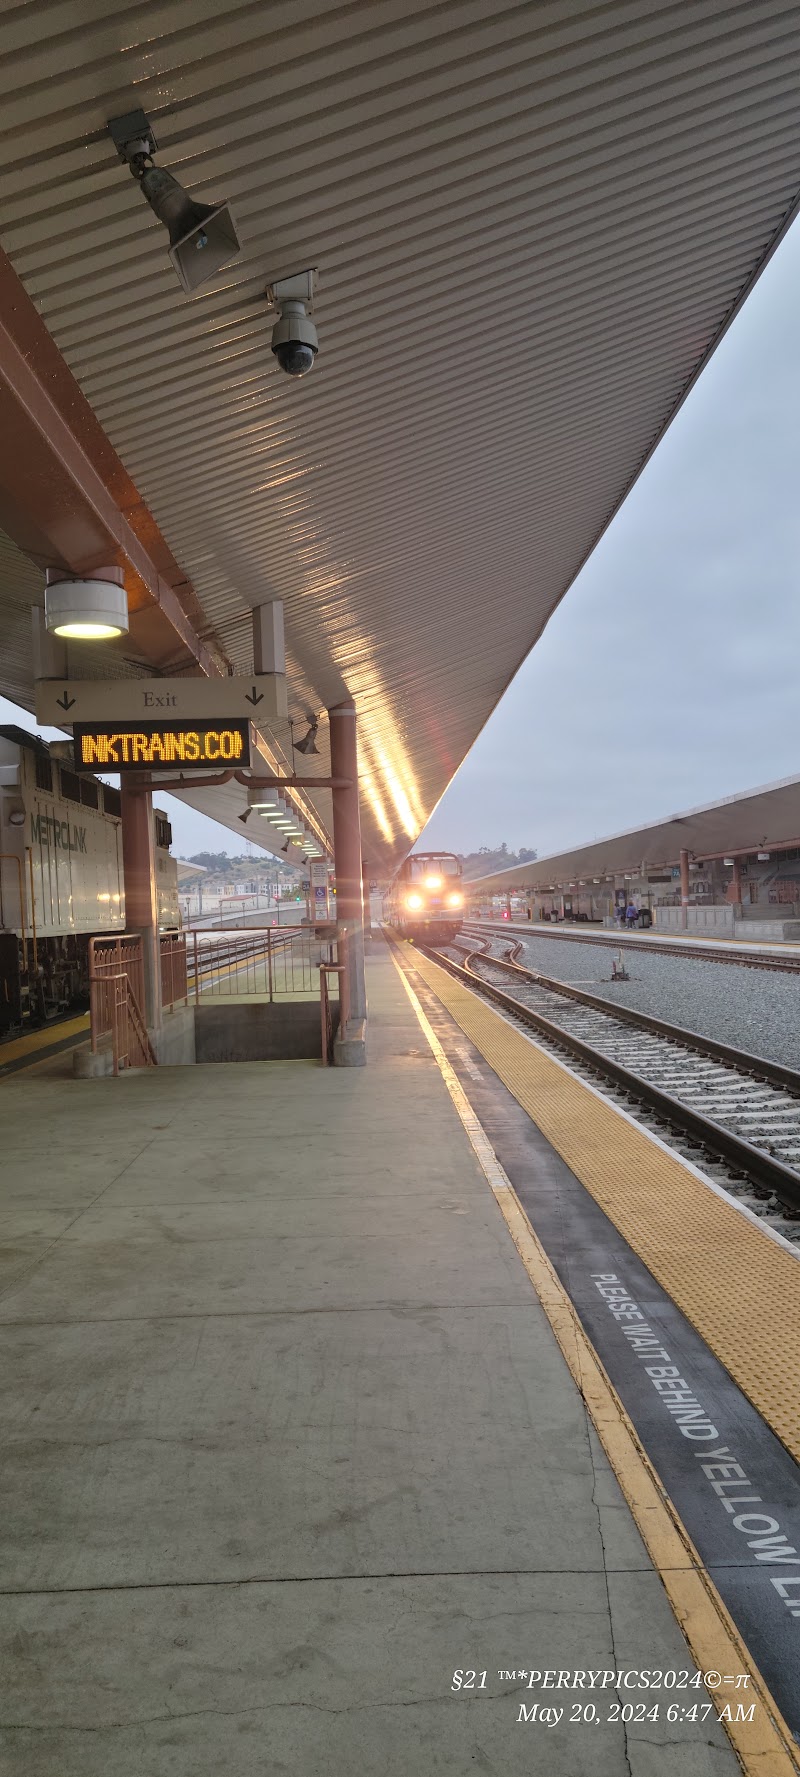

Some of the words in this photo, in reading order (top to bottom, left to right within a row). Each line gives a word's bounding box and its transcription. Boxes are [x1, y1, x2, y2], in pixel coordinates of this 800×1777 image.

[141, 691, 177, 707] Exit
[31, 812, 87, 854] METROLINK
[590, 1273, 645, 1321] PLEASE
[621, 1323, 672, 1362] WAIT
[645, 1366, 719, 1441] BEHIND
[694, 1446, 800, 1564] YELLOW
